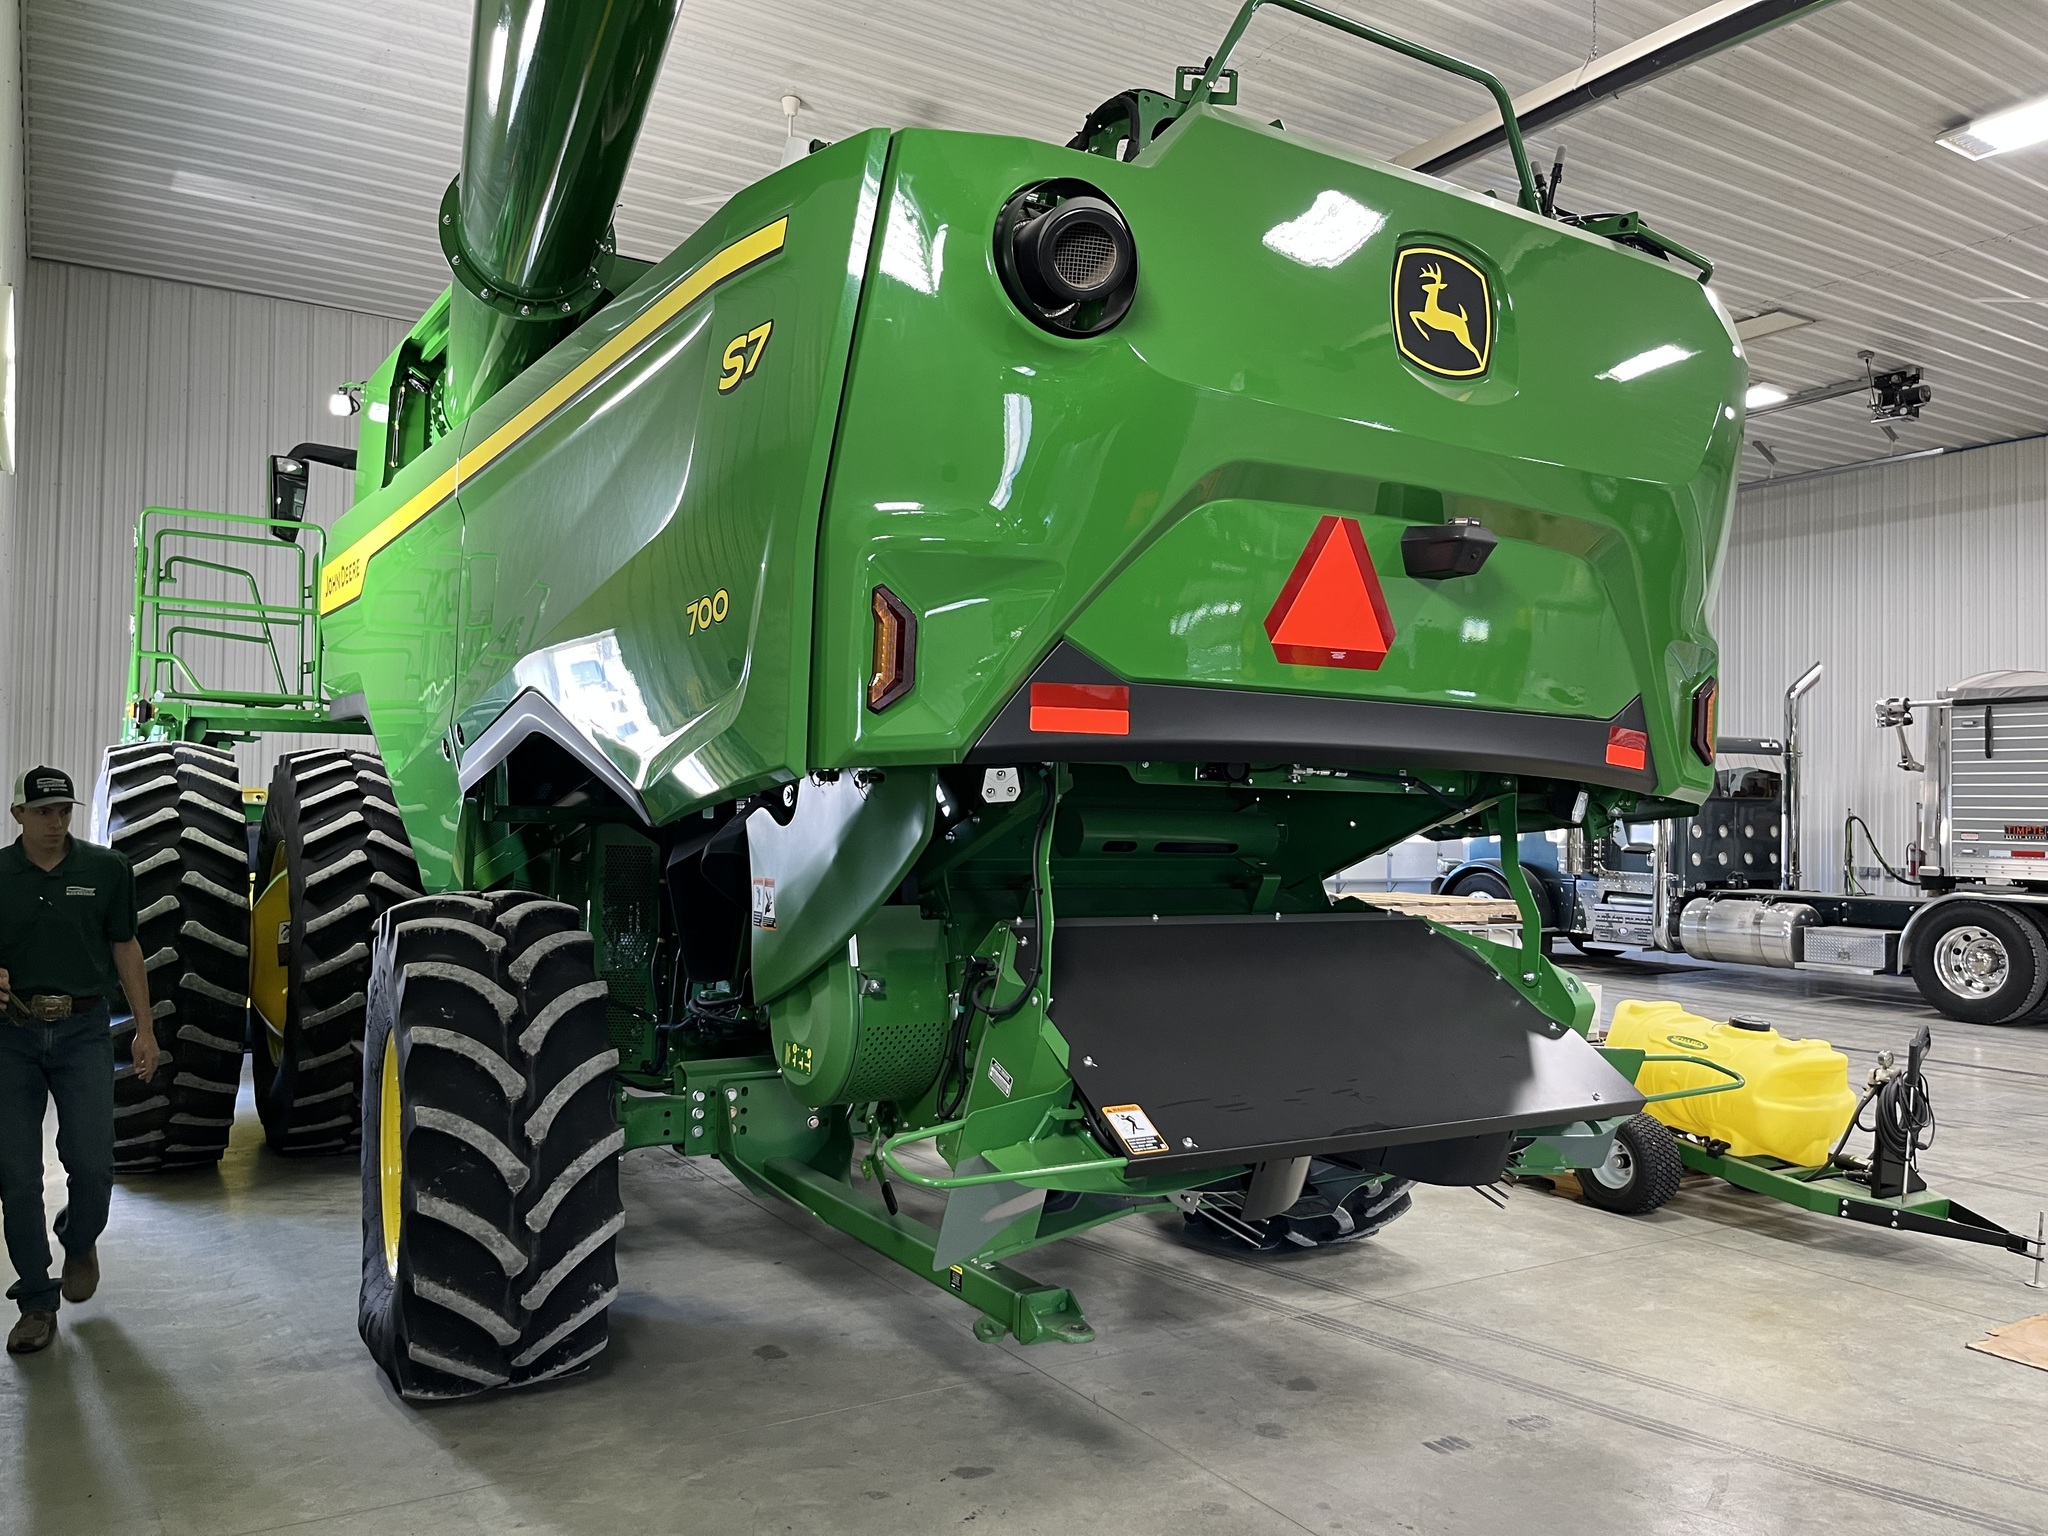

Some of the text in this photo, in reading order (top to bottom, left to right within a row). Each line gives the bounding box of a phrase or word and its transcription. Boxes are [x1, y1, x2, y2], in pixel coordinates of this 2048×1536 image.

[718, 318, 774, 395] S7
[325, 558, 360, 598] JOHN DEERE
[686, 588, 729, 637] 700
[2007, 825, 2045, 835] TIMPTE
